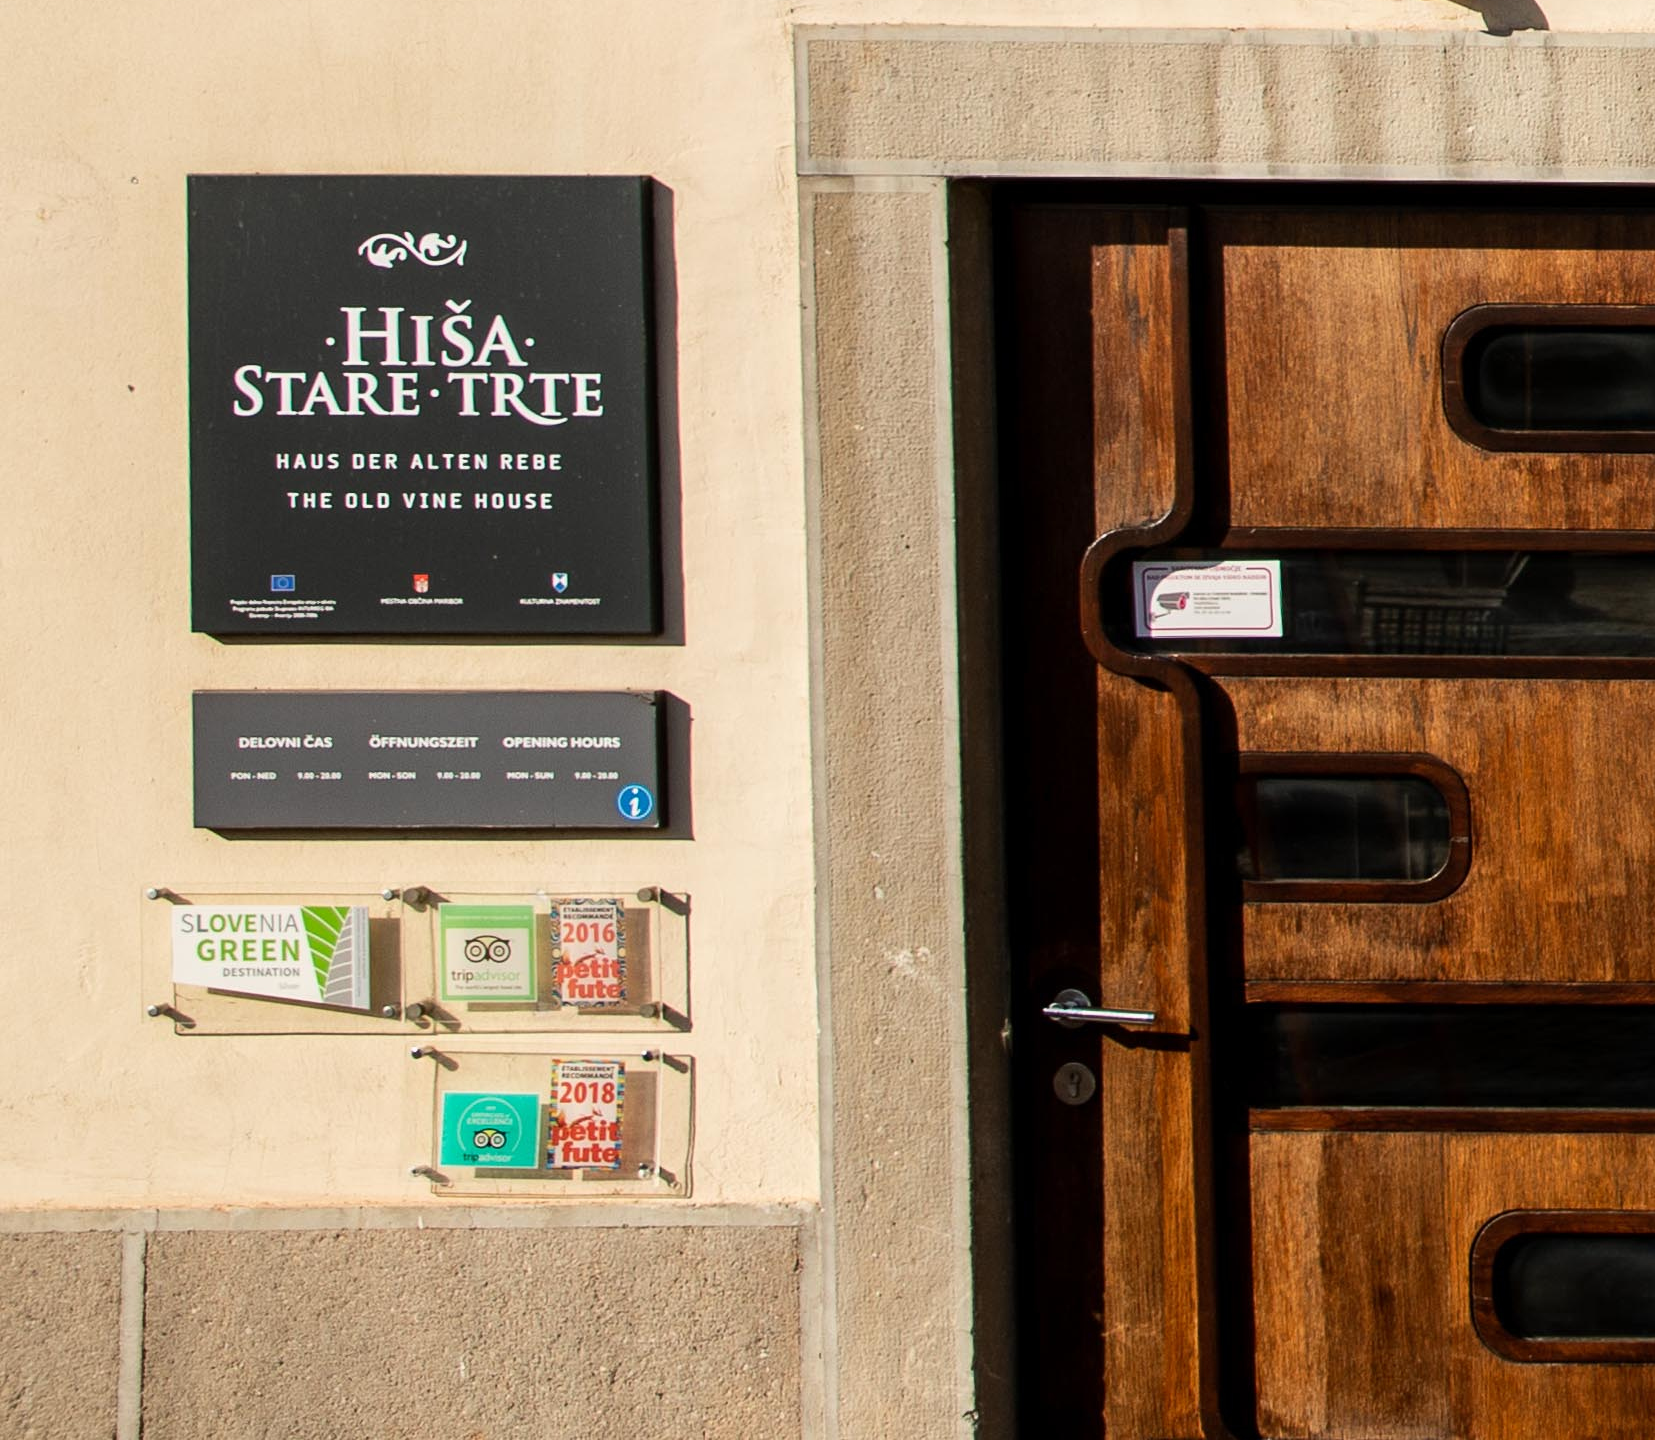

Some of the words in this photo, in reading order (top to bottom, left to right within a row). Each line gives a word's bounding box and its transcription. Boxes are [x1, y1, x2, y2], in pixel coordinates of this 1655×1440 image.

[276, 453, 338, 469] HAUS
[352, 453, 396, 469] DER
[410, 453, 486, 469] ALTEN
[500, 453, 561, 469] REBE
[287, 492, 332, 508] THE
[345, 493, 389, 508] OLD
[402, 493, 461, 508] VINE
[475, 493, 552, 509] HOUSE
[238, 737, 300, 747] DELOVNI
[303, 735, 332, 747] ČAS
[369, 735, 478, 747] ÖFFNUNGSZEIT
[502, 737, 567, 747] OPENING
[570, 737, 620, 747] HOURS
[181, 913, 299, 934] SLOVENIA
[562, 922, 615, 943] 2016
[197, 939, 301, 961] GREEN
[223, 968, 301, 978] DESTINATION
[451, 969, 521, 983] tripadvisor
[560, 1082, 616, 1103] 2018
